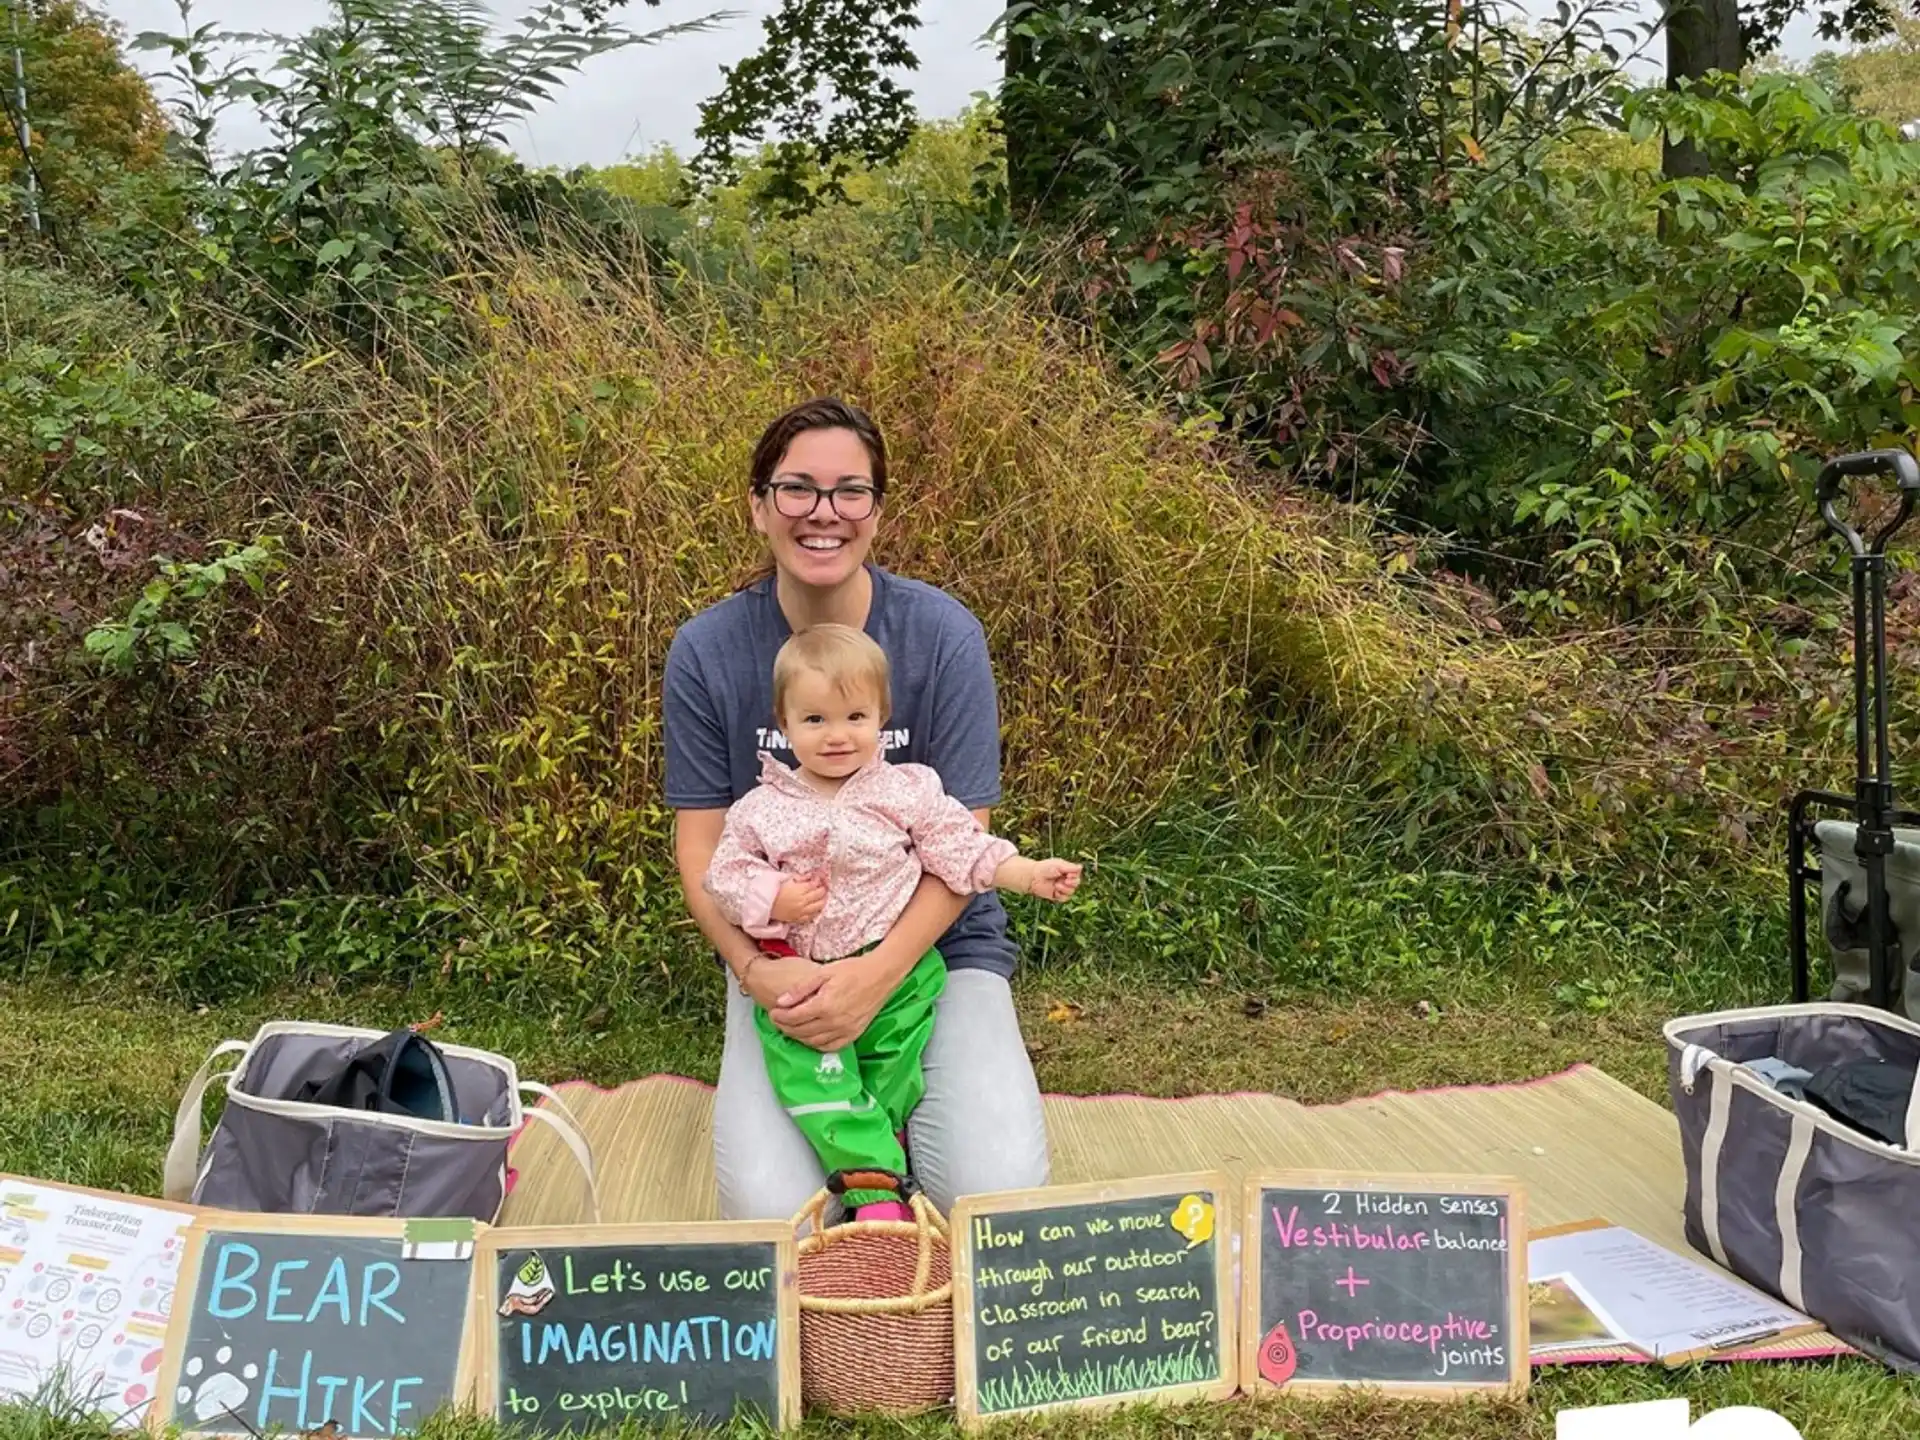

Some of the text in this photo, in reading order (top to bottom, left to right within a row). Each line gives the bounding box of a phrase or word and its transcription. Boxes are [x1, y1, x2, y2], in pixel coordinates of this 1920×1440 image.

[1323, 1193, 1499, 1217] 2 Hidden Senses
[975, 1212, 1166, 1250] How can we move
[208, 1242, 406, 1327] BEAR
[564, 1254, 773, 1296] Let's use our
[976, 1248, 1188, 1296] through our outdoor
[1099, 1290, 1121, 1308] in
[1136, 1281, 1201, 1304] search
[521, 1316, 777, 1365] IMAGINATION
[986, 1311, 1215, 1361] of our friend bear?
[1435, 1344, 1505, 1376] joints
[257, 1348, 424, 1436] HIKE
[505, 1380, 688, 1420] to explore!
